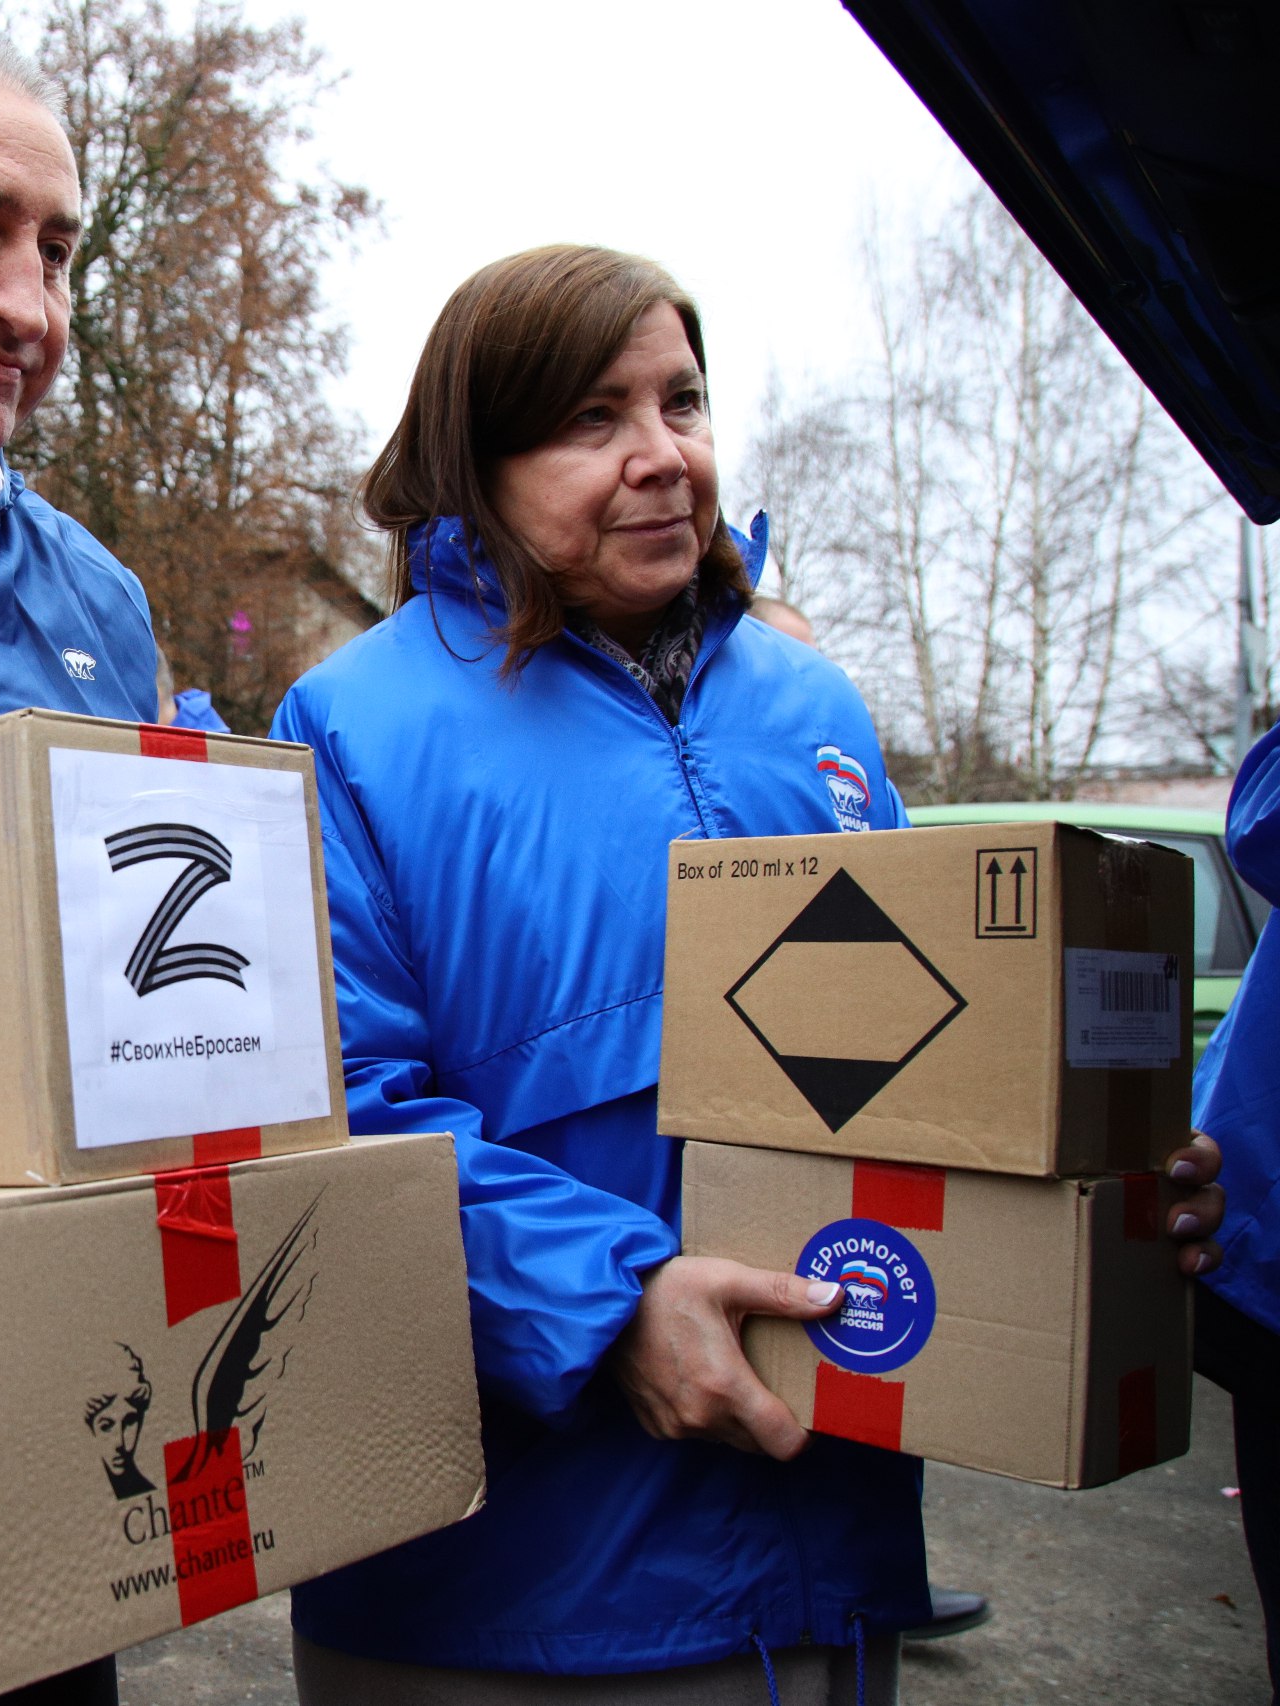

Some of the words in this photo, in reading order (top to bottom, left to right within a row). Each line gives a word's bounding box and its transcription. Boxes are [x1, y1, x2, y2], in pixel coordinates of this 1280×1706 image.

[677, 862, 705, 880] Box
[708, 860, 724, 879] of
[731, 859, 759, 878] 200
[763, 858, 781, 877] ml
[785, 861, 795, 876] x
[800, 856, 819, 875] 12
[104, 822, 250, 998] Z
[110, 1034, 262, 1063] #СвоихНеБросаем
[840, 1306, 884, 1322] ЕДИНАЯ
[840, 1316, 884, 1332] РОССИЯ
[123, 1476, 246, 1545] Chante
[110, 1529, 276, 1602] www.chante.ru
